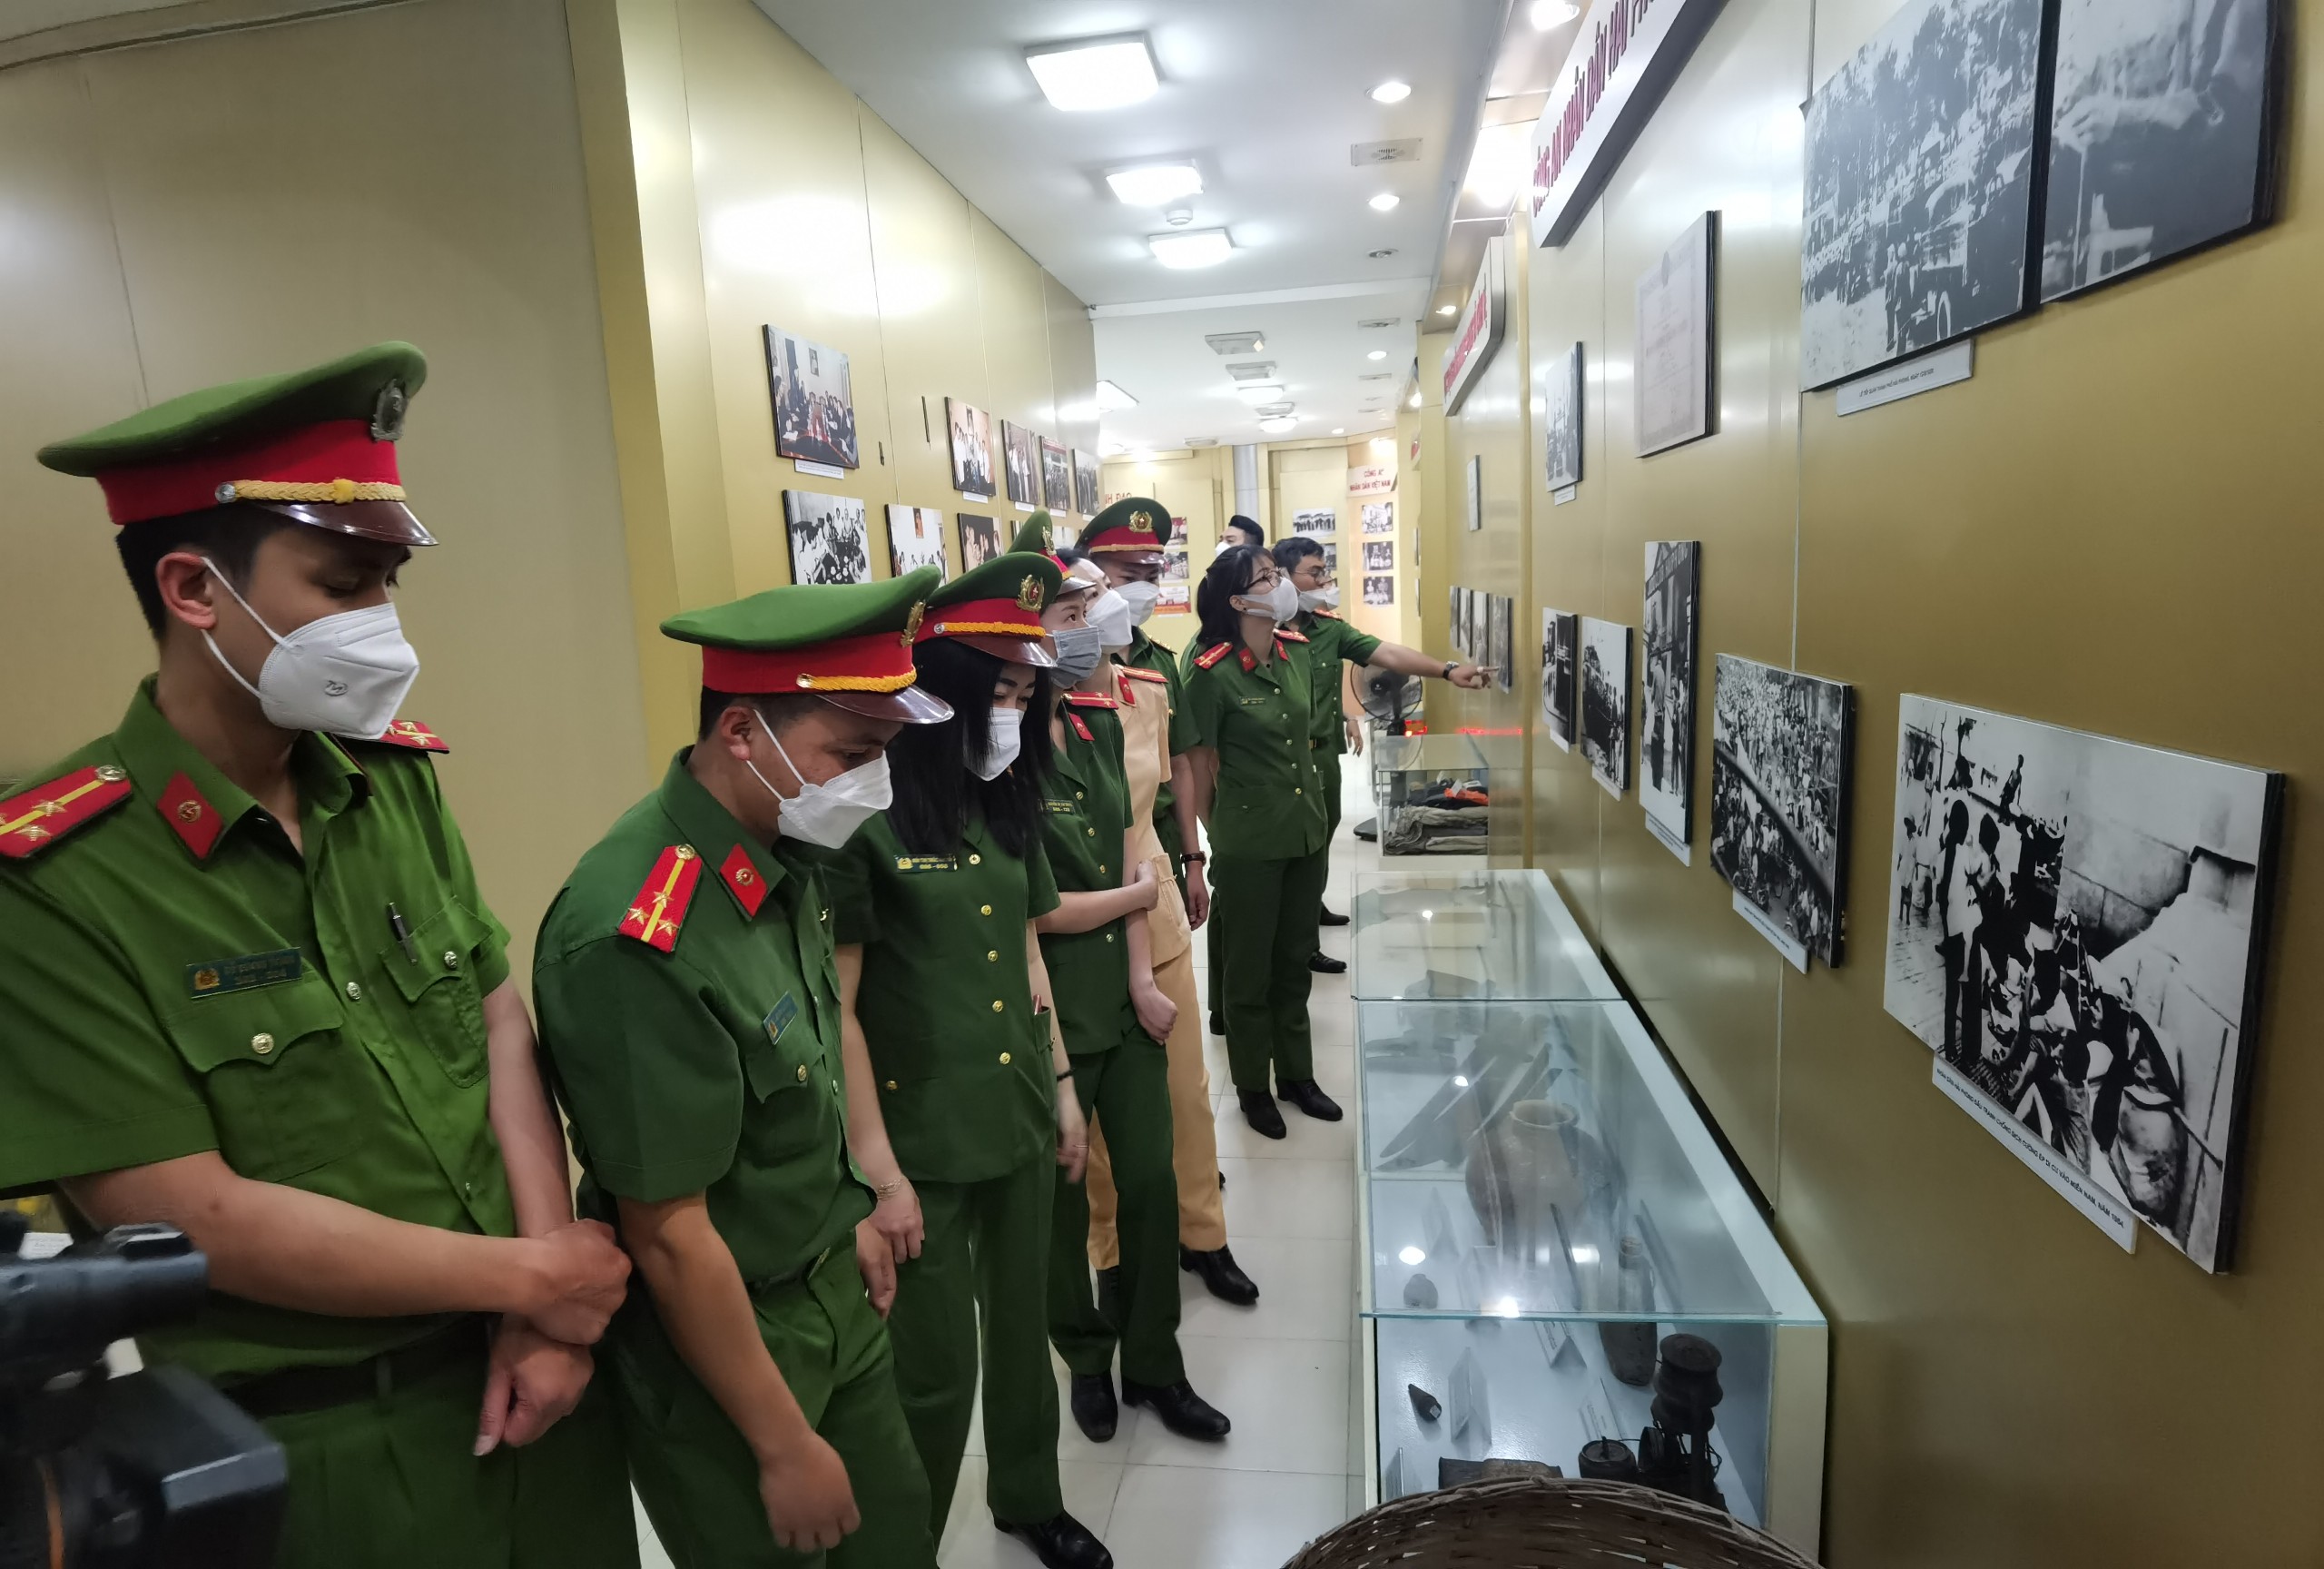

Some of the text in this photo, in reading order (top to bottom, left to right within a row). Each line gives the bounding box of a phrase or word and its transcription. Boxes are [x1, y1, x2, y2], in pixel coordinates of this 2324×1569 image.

[1551, 119, 1561, 187] AN
[1562, 65, 1586, 167] NHÂN
[1586, 20, 1607, 122] DÂN
